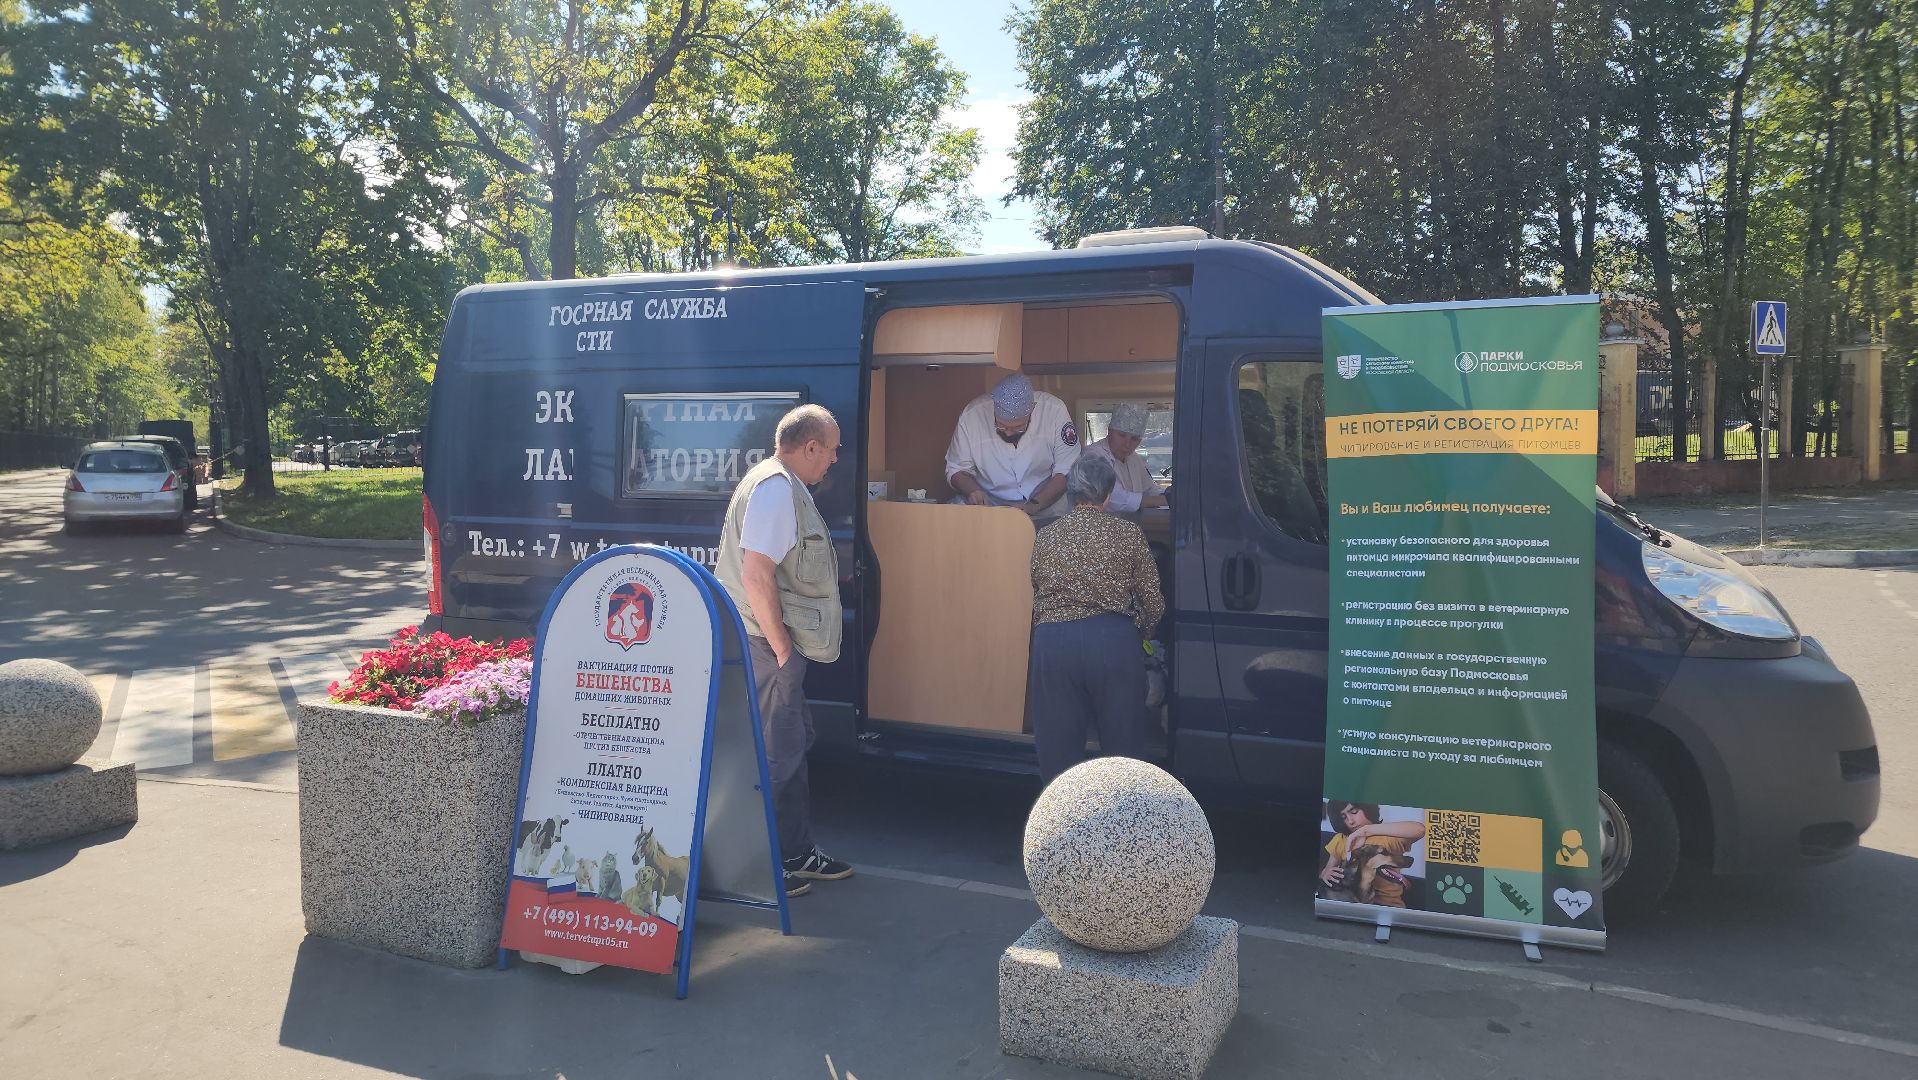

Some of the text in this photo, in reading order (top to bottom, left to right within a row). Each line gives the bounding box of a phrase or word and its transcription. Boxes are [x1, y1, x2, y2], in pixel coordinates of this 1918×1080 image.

[644, 297, 728, 320] СЛУЖБА
[576, 331, 613, 352] СТИ
[1480, 351, 1524, 360] ПАРКИ
[1480, 360, 1582, 372] ПОДМОСКОВЬЯ
[535, 390, 574, 423] ЭК
[1340, 415, 1579, 435] НЕ ПОТЕРЯЙ СВОЕГО ДРУГА!
[1340, 440, 1581, 452] ЧИПИРОВАНИЕ И РЕГИСТРАЦИЯ ПИТОМЦЕВ
[522, 448, 574, 481] ЛА
[1341, 500, 1551, 516] Вы и Ваш любимец получаете:
[469, 530, 560, 559] Тел.: +7
[1346, 536, 1550, 548] установку безопасного для здоровья
[1346, 552, 1580, 565] питомца микрочипа квалифицированными
[1346, 569, 1426, 578] специалистами
[1346, 601, 1570, 616] регистрацию без визита в ветеринарную
[1346, 617, 1385, 627] клинику
[1394, 619, 1447, 628] процессе
[1450, 620, 1504, 631] прогулки
[1345, 650, 1390, 658] внесение
[1392, 651, 1434, 660] данных
[1446, 654, 1547, 666] государственную
[577, 660, 674, 675] ВАКЦИНАЦИЯ ПРОТИВ
[1344, 665, 1528, 681] региональную базу Подмосковья
[576, 673, 672, 693] БЕШЕНСТВА
[1351, 681, 1409, 692] контактами
[1413, 685, 1474, 696] владельца
[1488, 687, 1568, 700] информацией
[575, 691, 672, 705] ДОМАШНИХ ЖИВОТНЫХ
[1351, 697, 1392, 708] питомце
[581, 713, 660, 731] БЕСПЛАТНО
[632, 736, 665, 745] ВАКЦИНА
[1342, 729, 1552, 751] устную консультацию ветеринарного
[611, 744, 651, 754] БЕШЕНСТВА
[1342, 745, 1543, 768] специалиста по уходу за любимцем
[587, 763, 642, 779] ПЛАТНО
[626, 784, 669, 796] ВАКЦИНА
[578, 810, 644, 824] ЧИПИРОВАНИЕ
[523, 906, 658, 938] +7 (499) 113-94-09
[544, 928, 628, 949] www.tervetupr05.ru
